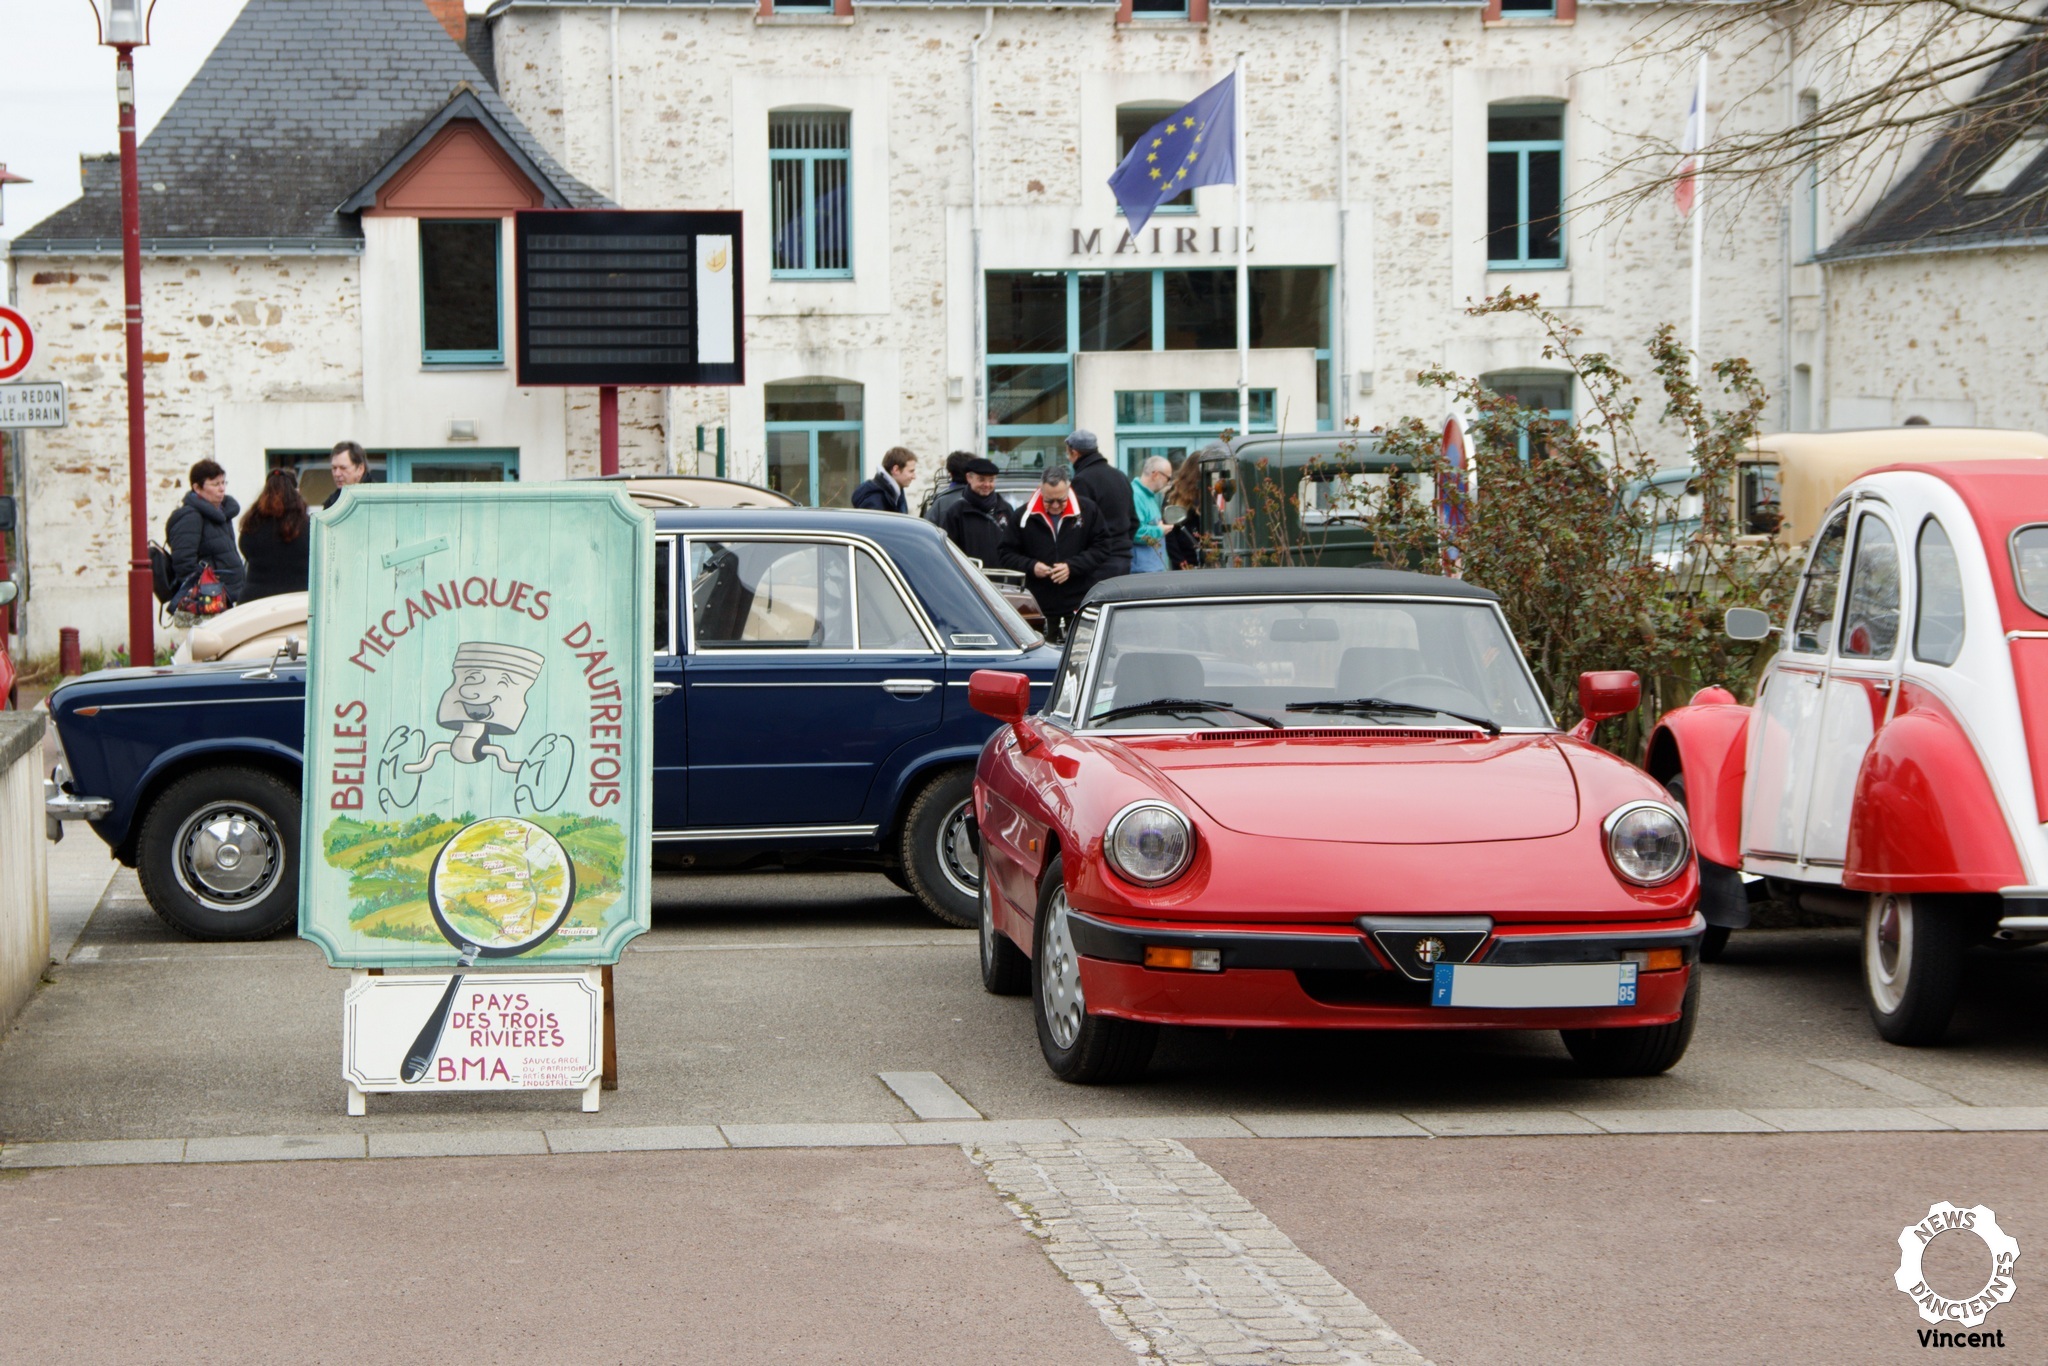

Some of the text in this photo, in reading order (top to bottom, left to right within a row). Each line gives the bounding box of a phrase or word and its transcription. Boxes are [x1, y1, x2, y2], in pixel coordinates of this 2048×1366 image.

[1070, 226, 1255, 255] MAIRIE
[22, 390, 59, 403] REDON
[28, 408, 60, 421] BRAIN
[330, 700, 367, 810] BELLES
[349, 576, 552, 673] MECANIQUES
[562, 620, 623, 808] D'AUTREFOIS
[1438, 988, 1446, 999] F
[1619, 985, 1636, 1002] 85
[472, 993, 529, 1011] PAYS
[452, 1012, 491, 1029] DES
[522, 1057, 579, 1065] SAUVEGARDE
[522, 1079, 574, 1087] INDUSTRIEL
